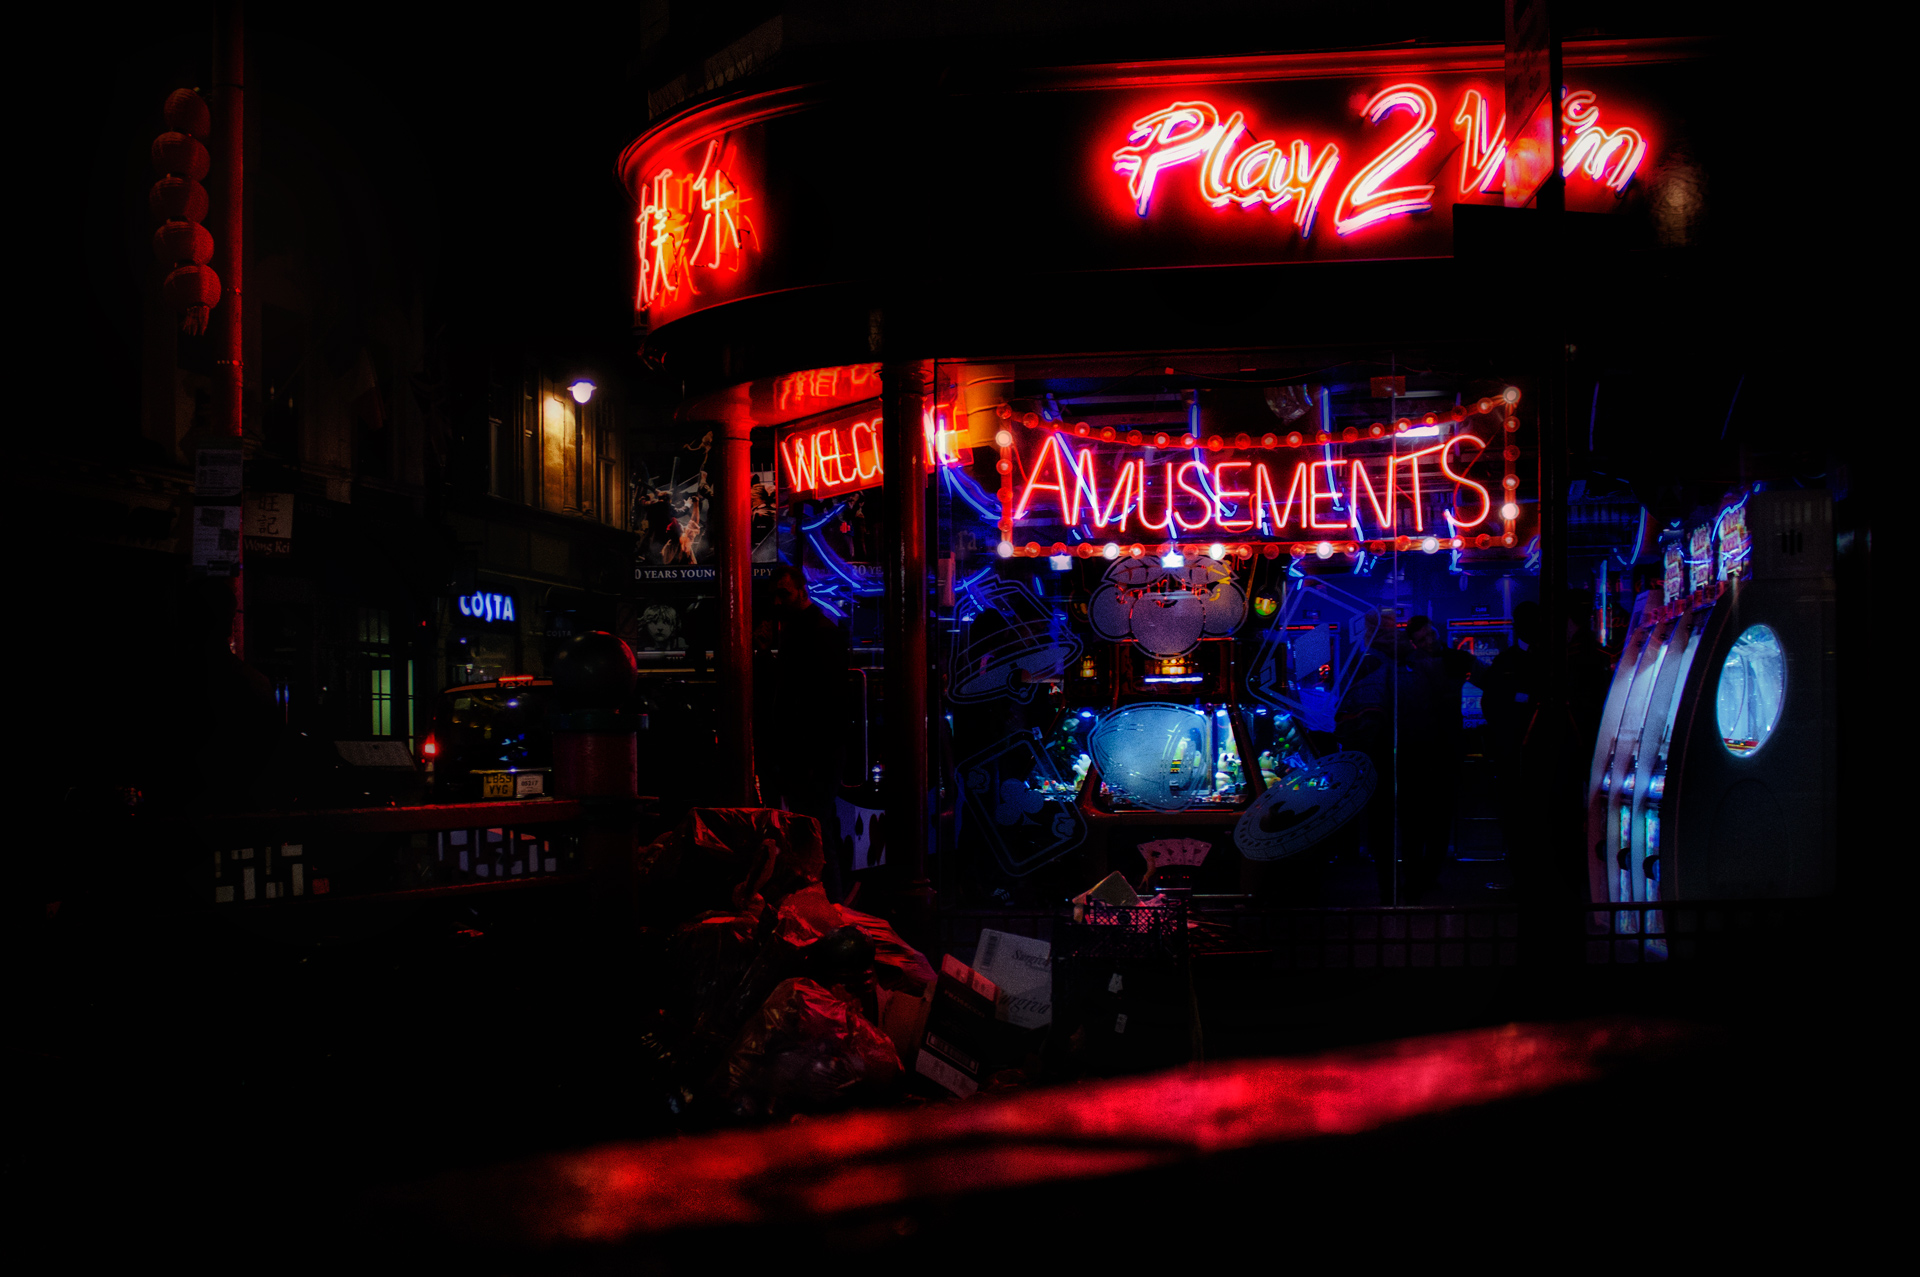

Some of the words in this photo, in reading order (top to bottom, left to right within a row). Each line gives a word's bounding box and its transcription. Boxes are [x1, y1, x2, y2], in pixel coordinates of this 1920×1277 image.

[1112, 99, 1340, 239] Play
[1335, 82, 1437, 238] 2
[1013, 433, 1492, 534] AMUSEMENTS
[258, 495, 279, 534] 旺記
[244, 538, 273, 556] Wong
[275, 540, 291, 554] Kei
[643, 569, 678, 579] YEARS
[458, 590, 516, 623] COSTA
[545, 629, 573, 638] COSTA
[498, 680, 534, 688] TAXI
